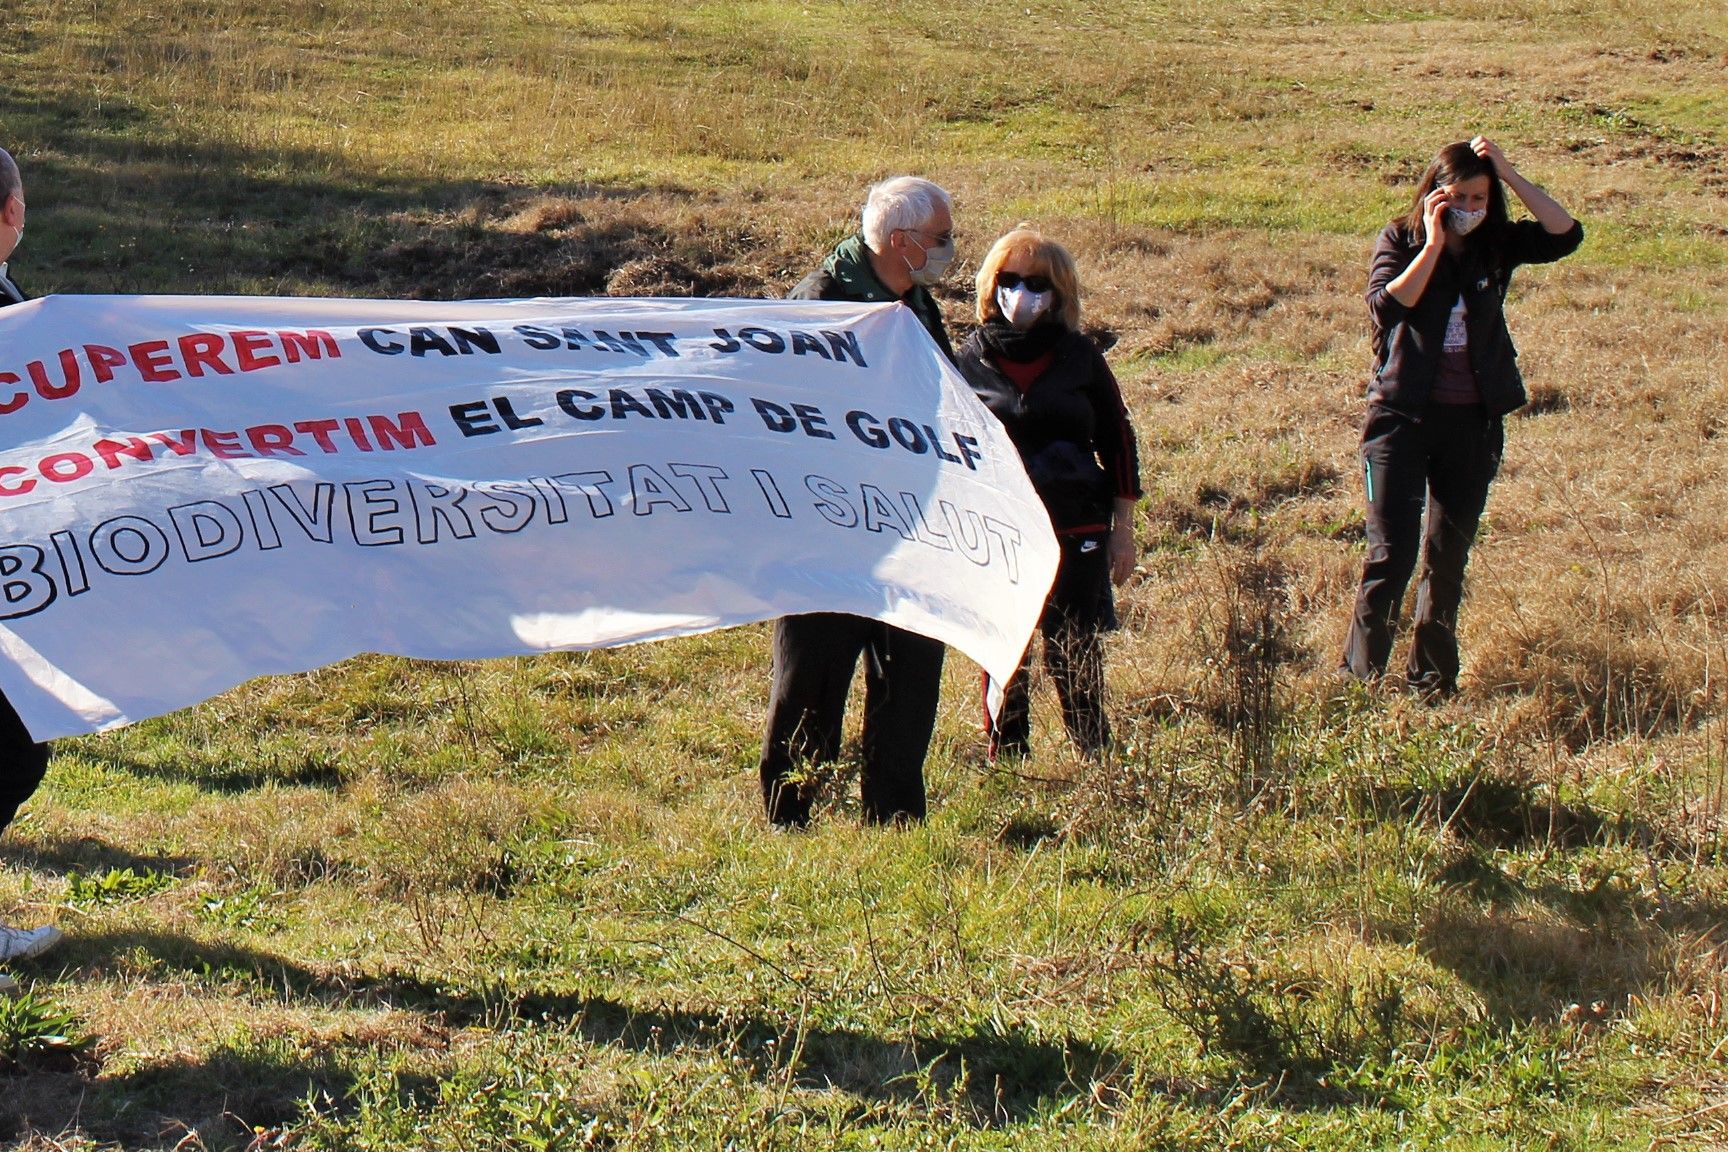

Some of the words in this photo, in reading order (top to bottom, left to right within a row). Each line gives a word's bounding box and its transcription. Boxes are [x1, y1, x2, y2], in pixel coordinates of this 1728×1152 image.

[357, 327, 502, 358] CAN
[513, 324, 680, 358] SANT
[709, 327, 868, 368] JOAN
[449, 395, 544, 438] EL
[555, 389, 734, 425] CAMP
[749, 397, 837, 441] DE
[845, 410, 982, 471] GOLF
[750, 469, 793, 519] I
[804, 474, 1022, 585] SALUT
